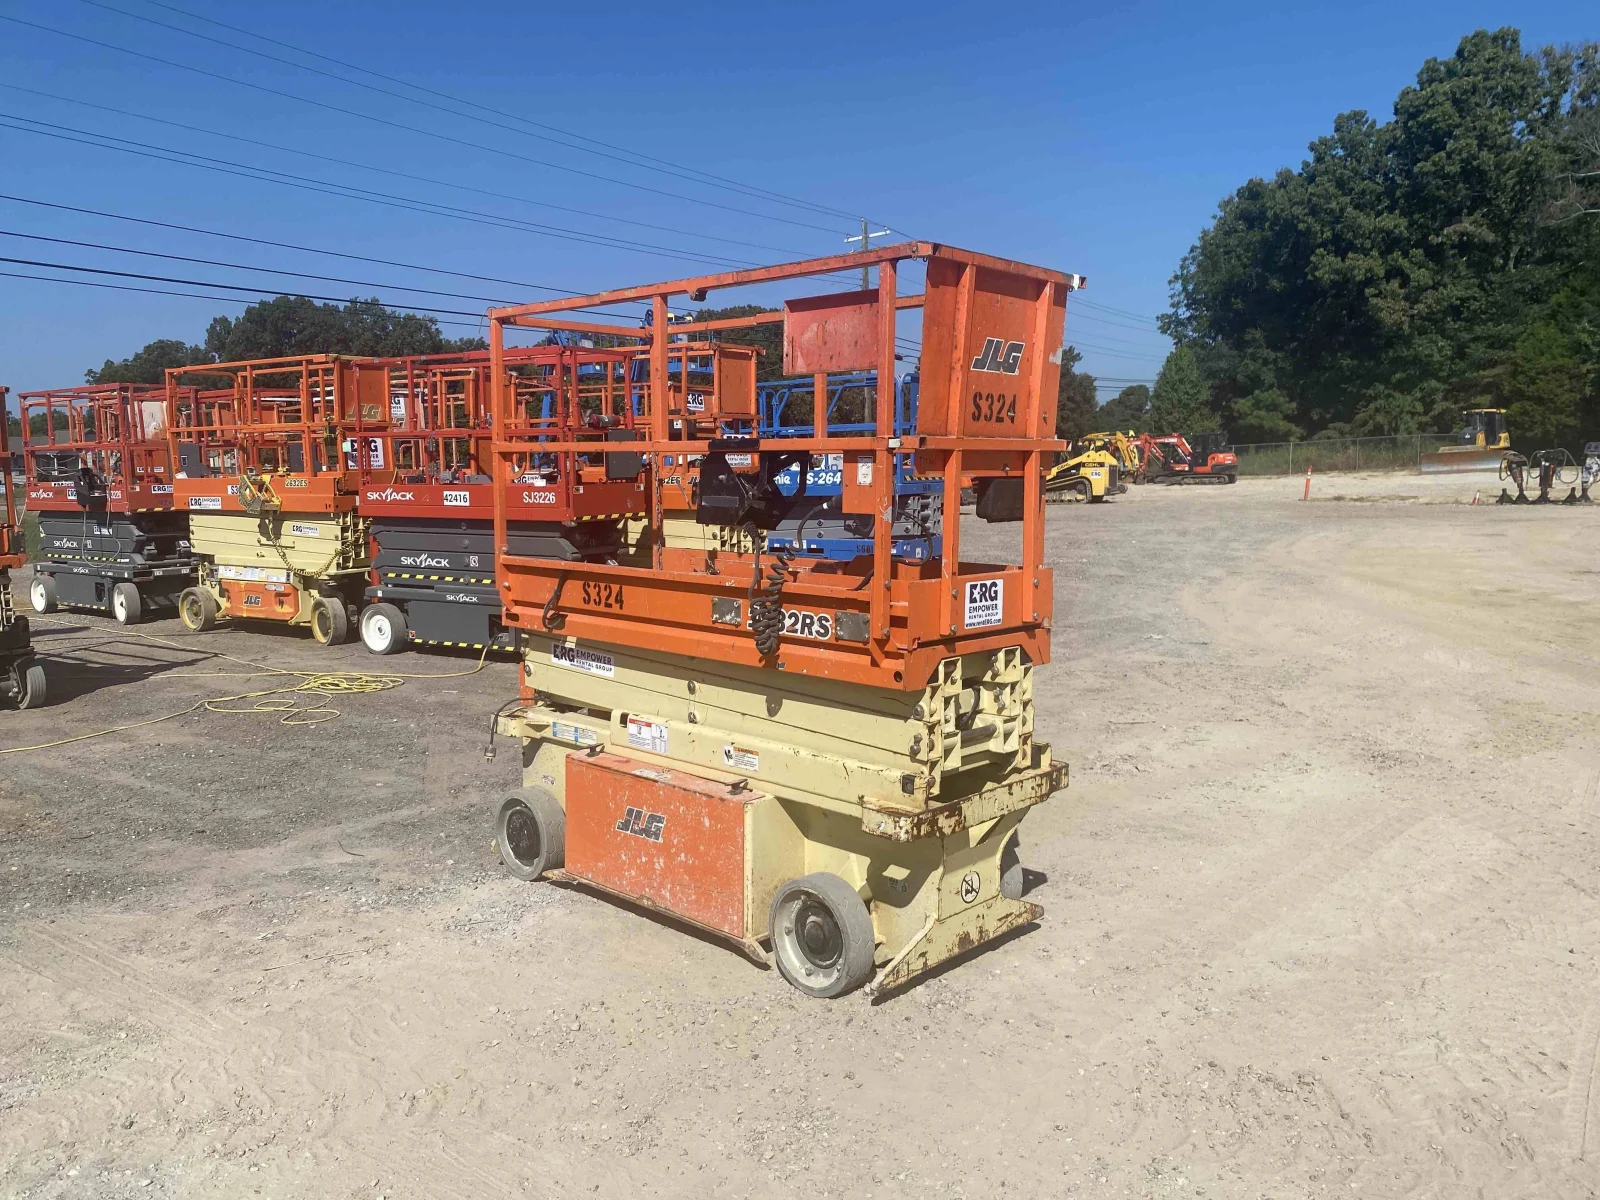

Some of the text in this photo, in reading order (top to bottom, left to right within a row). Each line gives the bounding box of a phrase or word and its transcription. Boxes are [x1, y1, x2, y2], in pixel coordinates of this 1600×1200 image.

[970, 337, 1025, 375] JLG
[971, 391, 1017, 424] S324
[797, 472, 842, 485] S-264
[29, 489, 54, 499] SKYJACK
[366, 487, 415, 502] SKYJACK
[443, 493, 468, 503] 42416
[522, 491, 556, 504] SJ3226
[190, 498, 202, 506] ERG
[53, 538, 78, 548] SKYJACK
[400, 553, 450, 567] SKYJACK
[446, 594, 478, 603] SKYJACK
[582, 581, 624, 610] S324
[969, 581, 999, 604] ERG
[244, 594, 262, 606] JLG
[968, 604, 999, 614] EMPOWER
[553, 643, 612, 666] ERG EMPOWER
[576, 660, 613, 673] RENTAL GROUP
[615, 805, 666, 843] JLG
